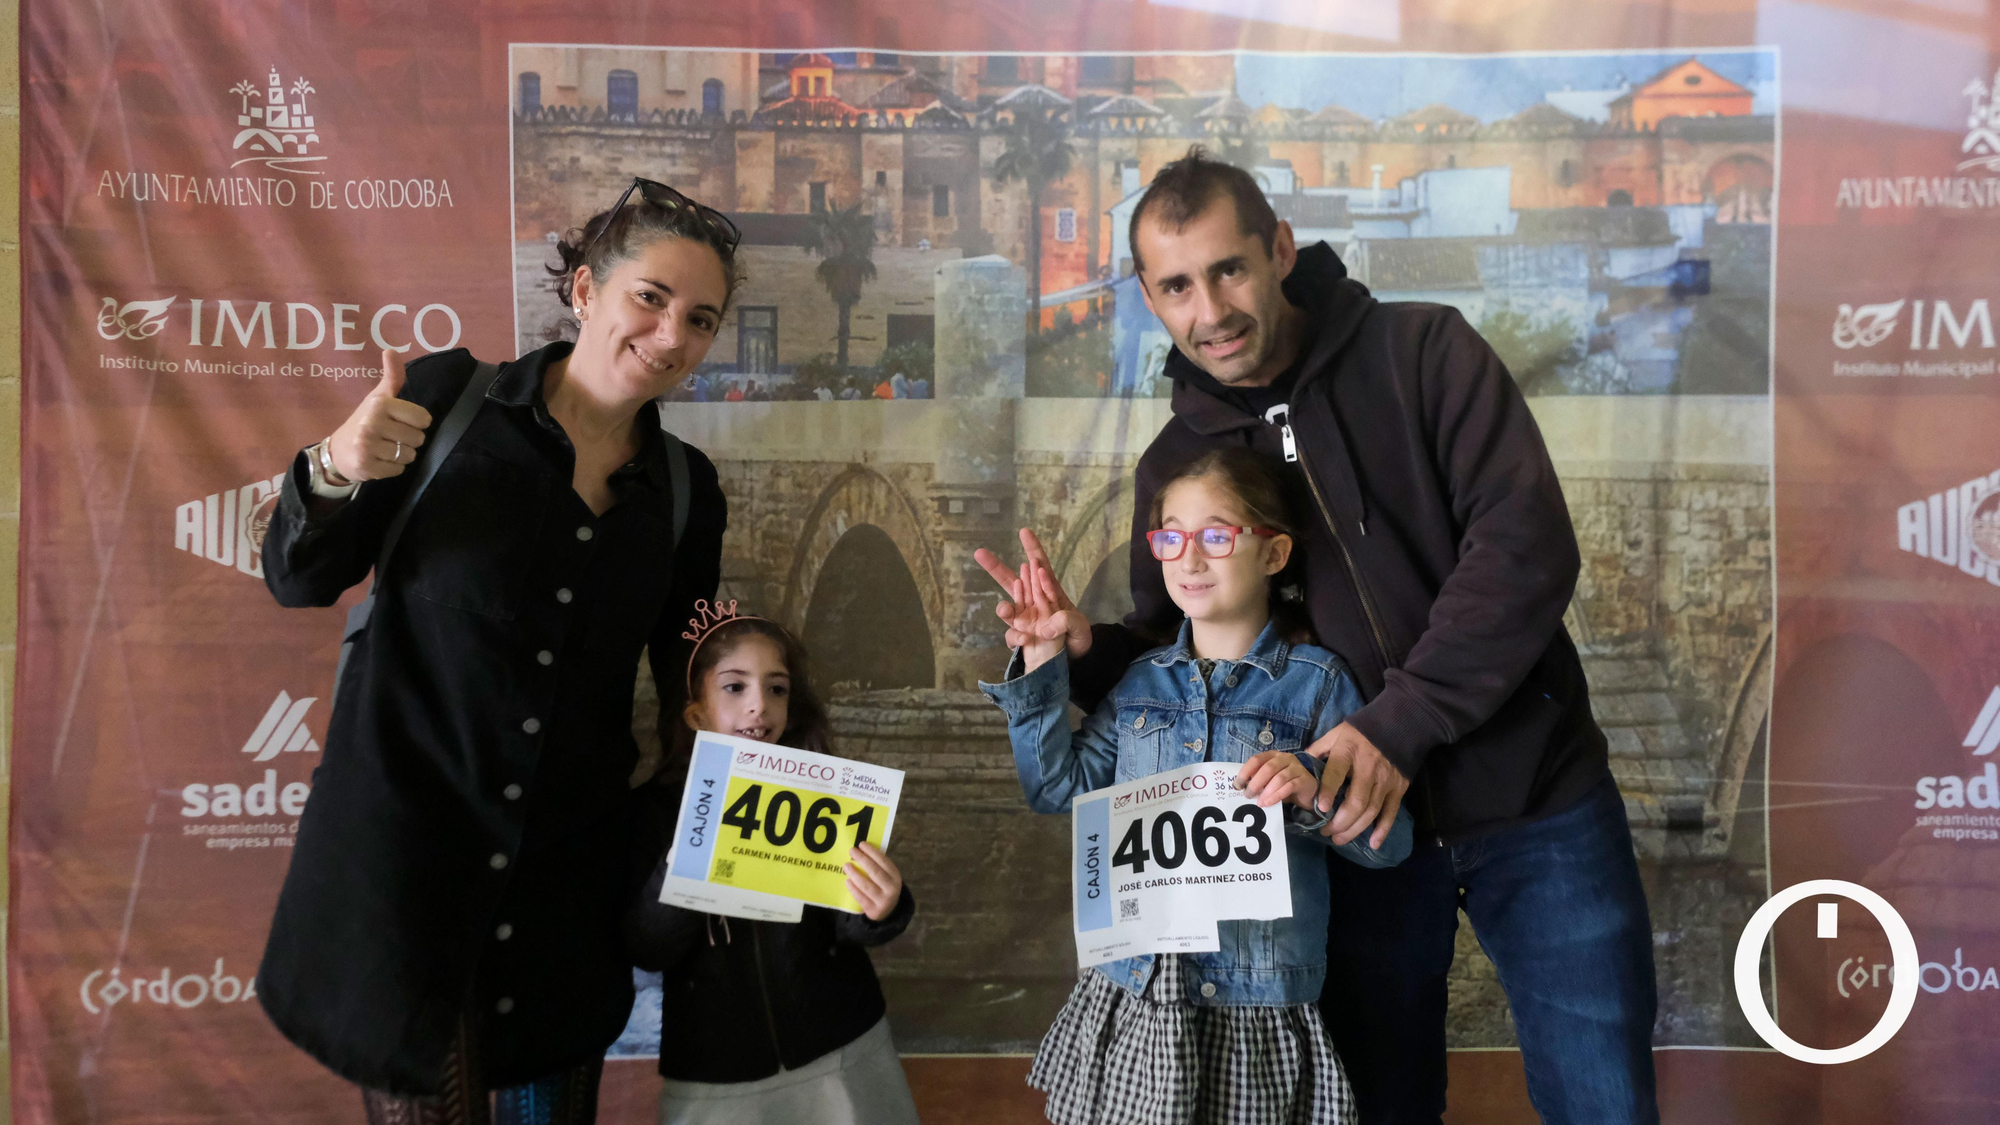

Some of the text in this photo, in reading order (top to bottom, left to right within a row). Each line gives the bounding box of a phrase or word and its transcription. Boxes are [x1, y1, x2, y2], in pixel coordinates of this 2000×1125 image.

[96, 170, 296, 207] AYUNTAMIENTO
[310, 181, 337, 209] DE
[189, 298, 462, 354] IMDECO
[99, 354, 386, 381] Instituto Municipal de Deportes
[175, 471, 286, 578] AUC
[759, 754, 836, 781] IMDECO
[853, 774, 877, 785] MEDIA
[181, 768, 311, 817] sade
[840, 777, 851, 786] 36
[852, 783, 891, 795] MARATÓN
[1136, 774, 1208, 804] IMDECO
[1215, 782, 1226, 790] 36
[690, 779, 716, 847] CAJÓN 4
[721, 783, 875, 859] 4061
[206, 836, 271, 851] empresa
[1112, 803, 1272, 874] 4063
[1932, 827, 1999, 841] empresa
[731, 846, 771, 860] CARMEN
[773, 852, 814, 869] MORENO
[1084, 833, 1100, 899] CAJÓN 4
[1118, 872, 1273, 893] JOSÉ CARLOS MARTINEZ COBOS
